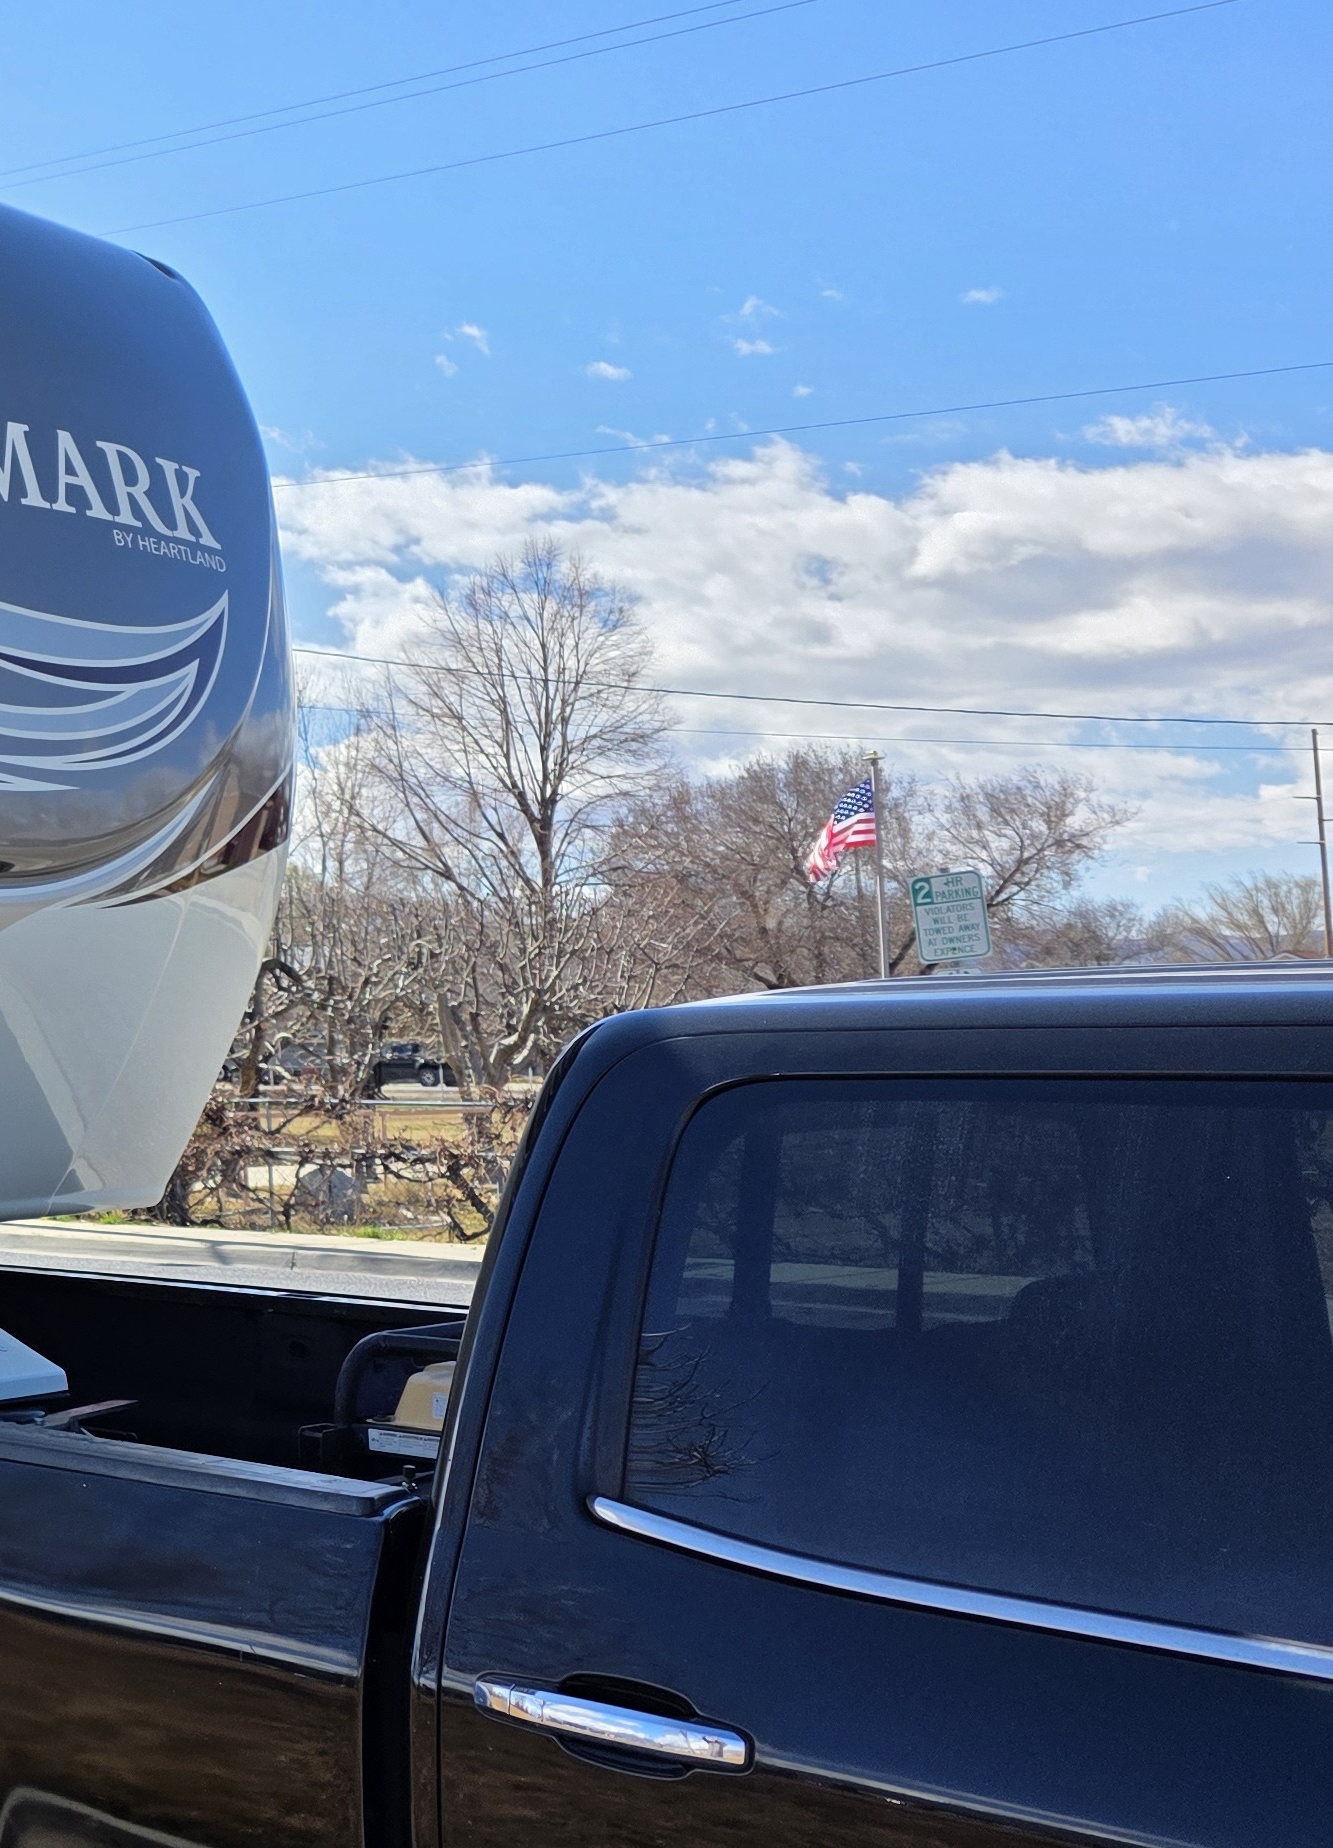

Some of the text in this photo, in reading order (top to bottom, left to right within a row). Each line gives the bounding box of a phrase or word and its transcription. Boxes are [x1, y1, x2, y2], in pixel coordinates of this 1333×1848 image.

[113, 529, 227, 573] BY HEARTLAND
[946, 876, 962, 887] HR
[914, 881, 932, 904] 2
[934, 886, 978, 901] PARKING
[924, 902, 975, 916] VIOLATORS
[933, 913, 970, 925] WILL BE
[922, 922, 980, 936] TOWED AWAY
[928, 933, 980, 947] AT OWNERS
